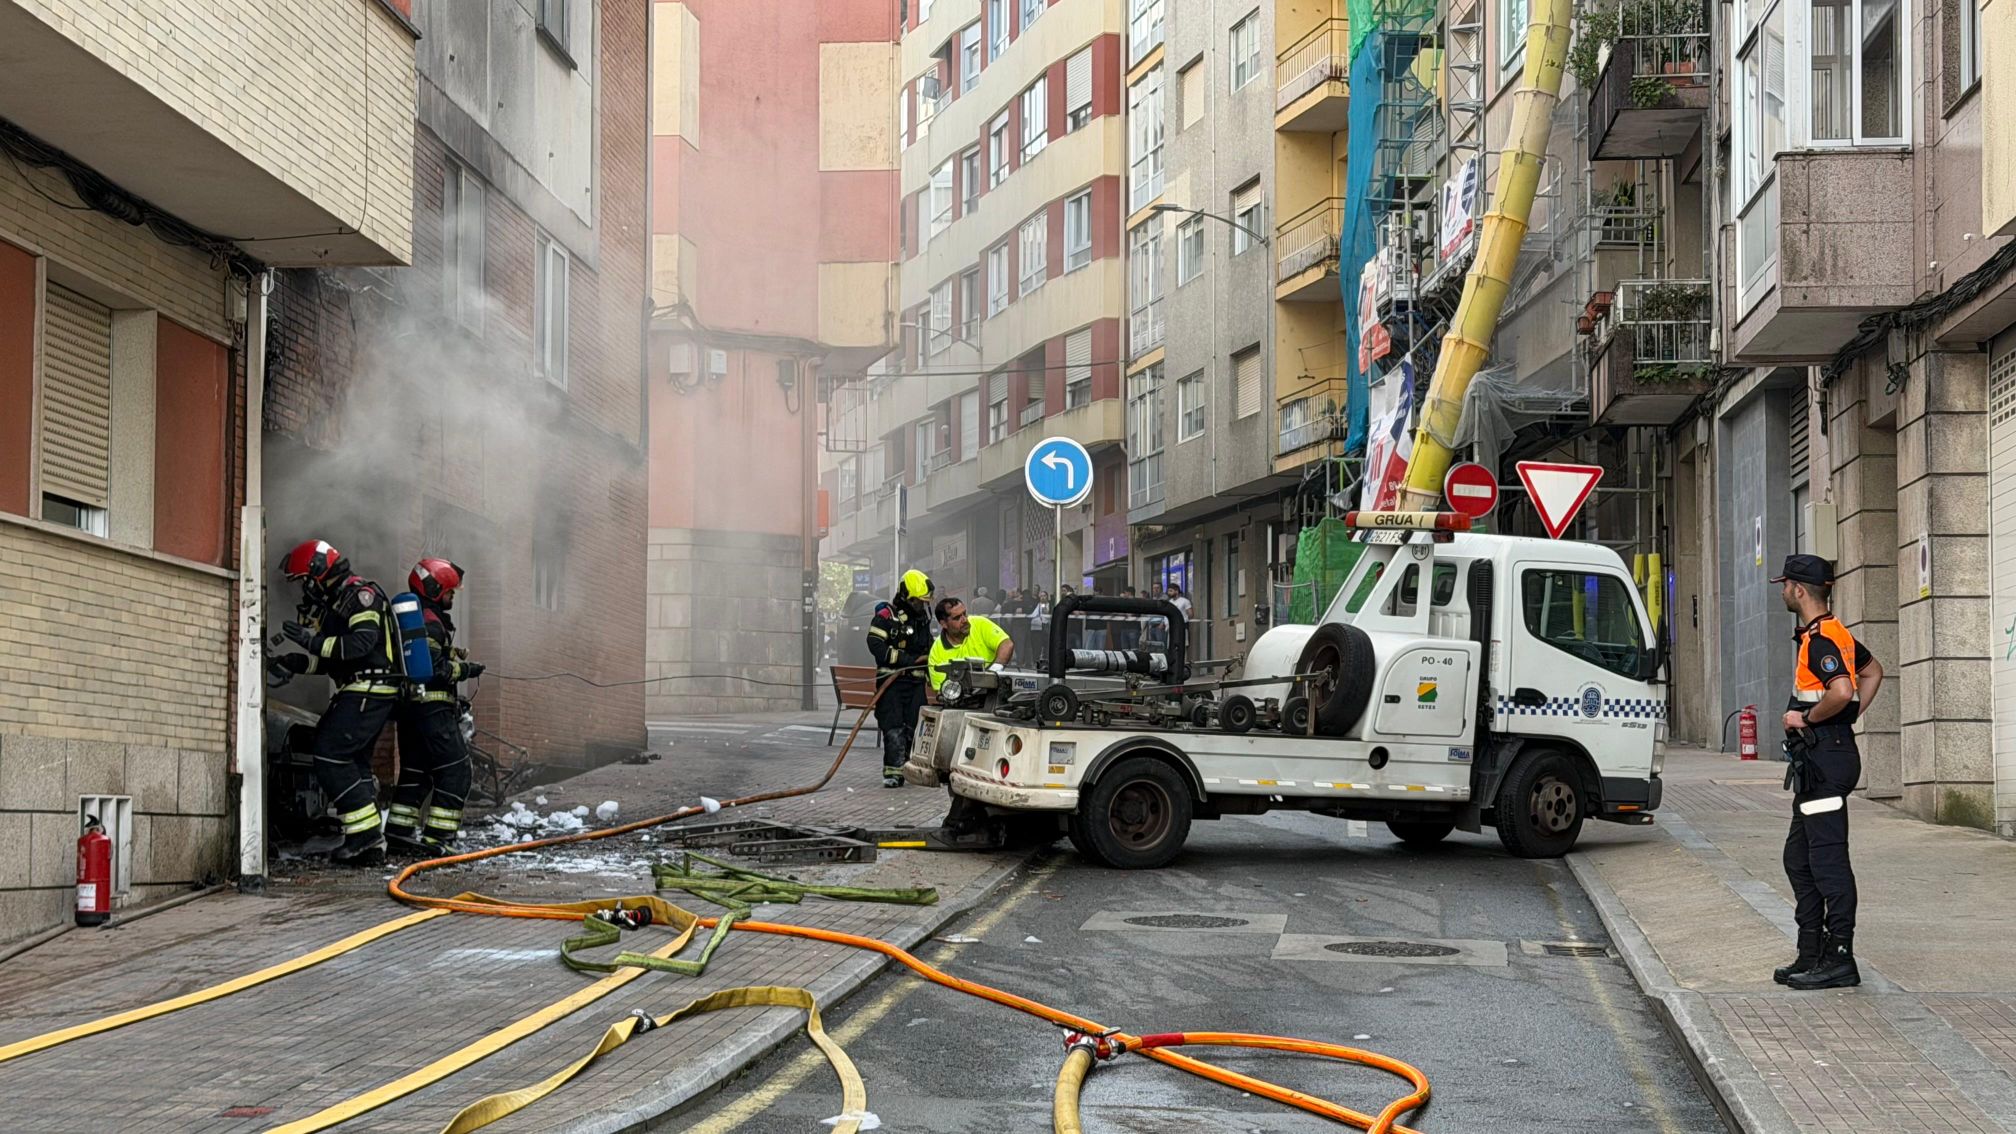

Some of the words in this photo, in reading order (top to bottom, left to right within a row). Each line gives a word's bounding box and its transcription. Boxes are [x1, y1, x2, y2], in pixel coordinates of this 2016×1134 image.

[1374, 514, 1414, 526] GRUA
[1421, 656, 1435, 665] PO
[1442, 657, 1453, 666] 40
